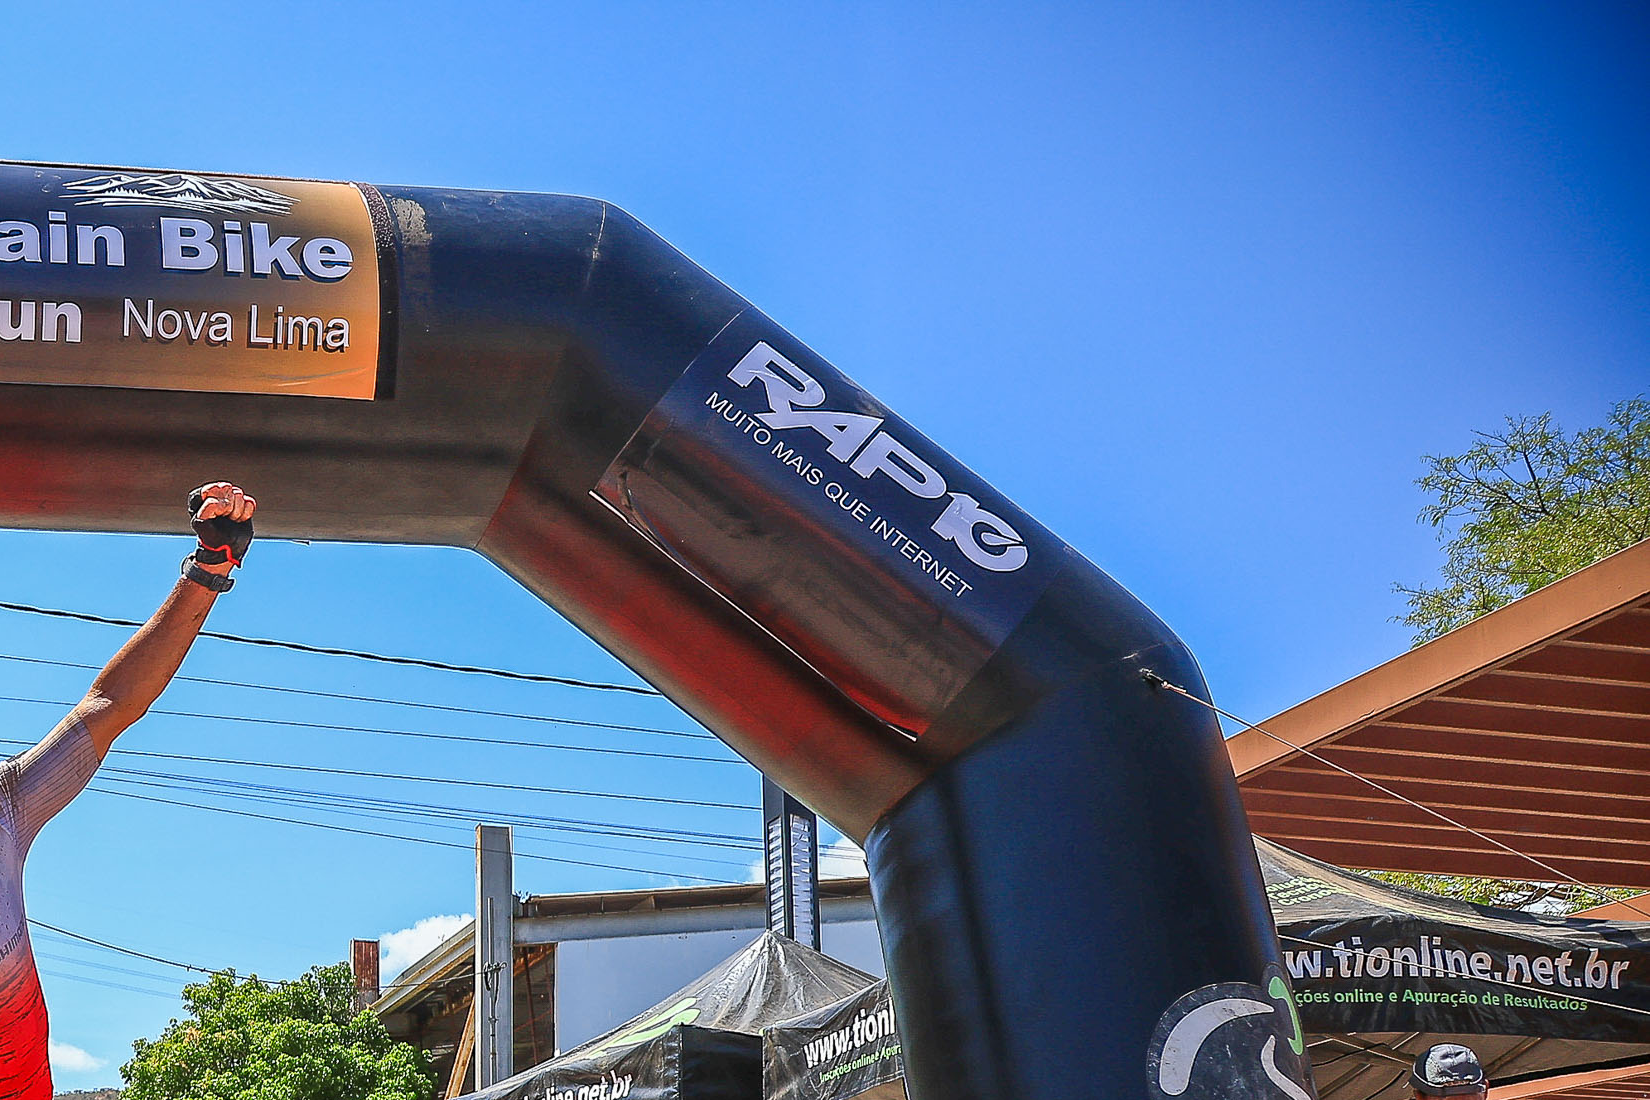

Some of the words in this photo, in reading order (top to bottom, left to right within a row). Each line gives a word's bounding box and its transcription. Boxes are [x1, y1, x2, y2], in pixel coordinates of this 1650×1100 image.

[158, 215, 354, 281] Bike
[121, 297, 234, 344] Nova
[250, 304, 351, 351] Lima
[705, 391, 772, 446] MUITO
[771, 440, 825, 486] MAIS
[824, 481, 872, 522] QUE
[869, 515, 973, 598] INTERNET
[1334, 989, 1384, 1004] online
[1388, 992, 1398, 1003] e
[1402, 989, 1476, 1008] Apuração
[1482, 991, 1501, 1007] de
[1503, 993, 1589, 1012] Resultados
